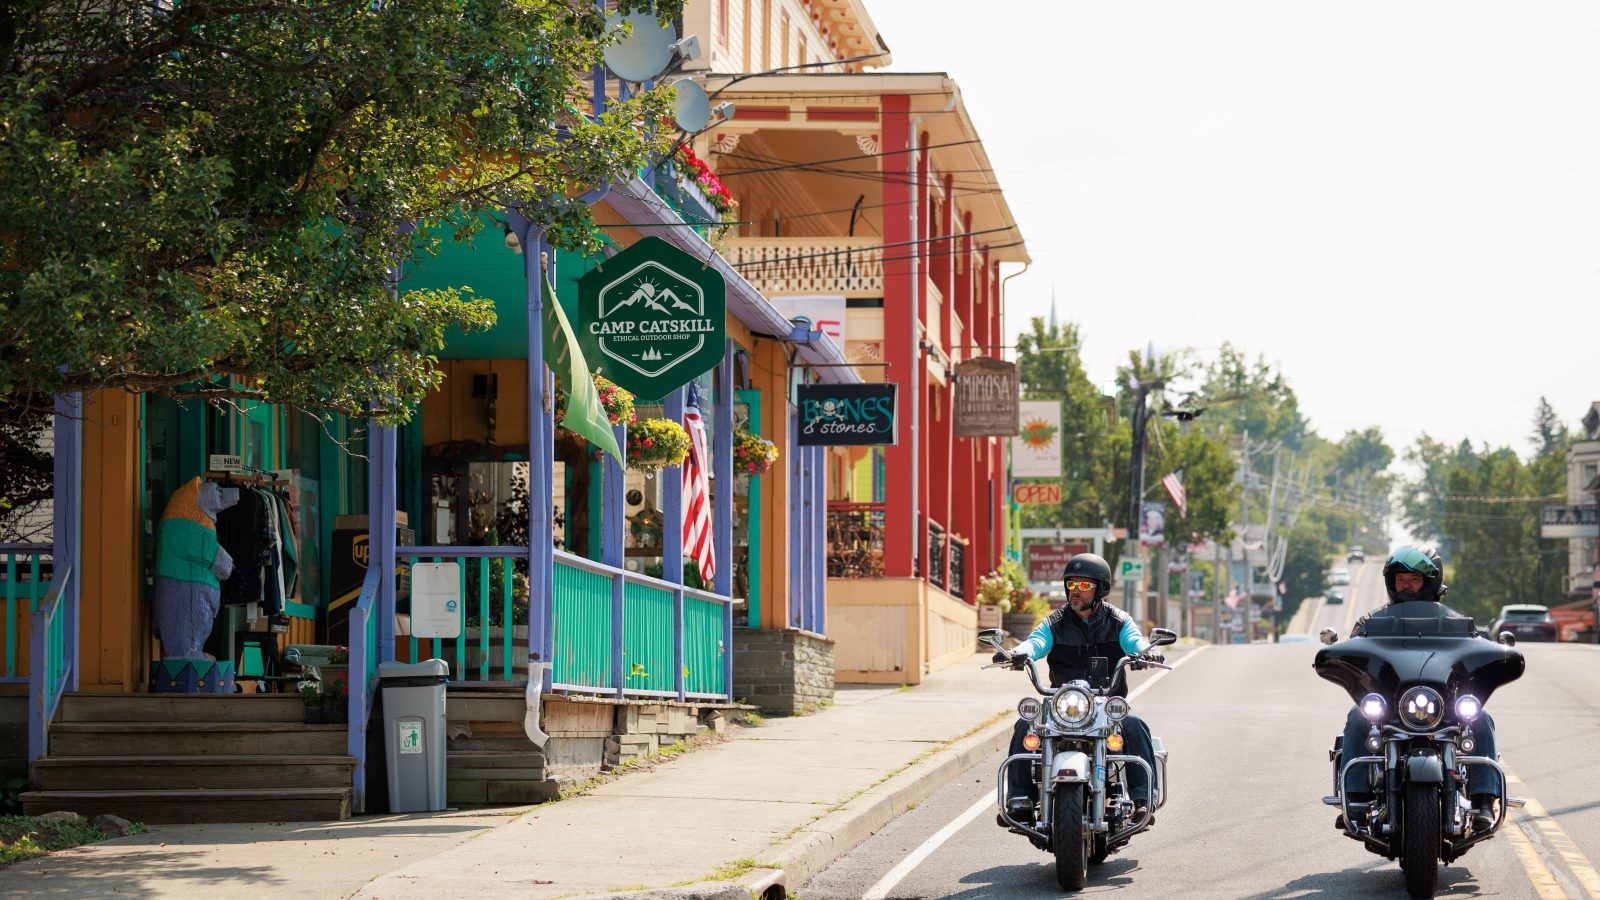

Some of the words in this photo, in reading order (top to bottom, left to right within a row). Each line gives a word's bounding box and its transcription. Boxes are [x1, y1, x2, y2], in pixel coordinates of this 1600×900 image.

[589, 321, 636, 335] CAMP
[639, 318, 715, 333] CATSKILL
[962, 374, 1010, 401] MIMOSA
[801, 396, 893, 433] BONES
[803, 419, 816, 435] &
[820, 420, 876, 434] stones
[223, 457, 241, 465] NEW
[1015, 486, 1060, 504] OPEN
[355, 545, 370, 563] up
[1122, 561, 1133, 576] P
